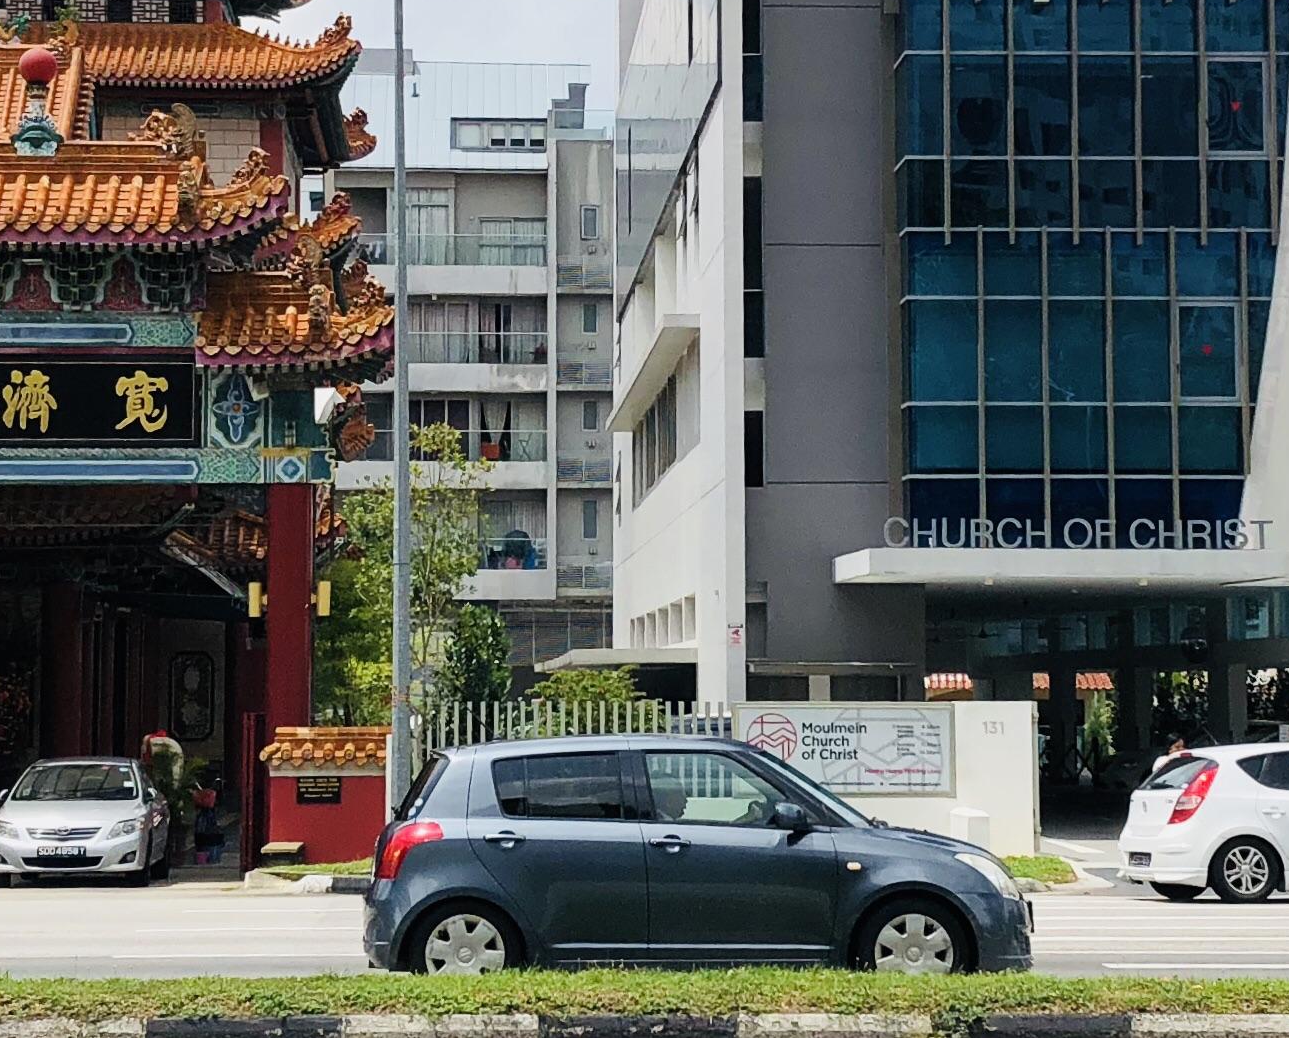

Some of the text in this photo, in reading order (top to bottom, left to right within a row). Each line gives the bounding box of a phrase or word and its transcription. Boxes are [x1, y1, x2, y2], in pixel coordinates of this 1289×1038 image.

[883, 517, 1273, 550] CHURCH OF CHRIST
[801, 722, 868, 734] Moulmein
[982, 721, 1005, 735] 131
[801, 735, 851, 747] Church
[801, 748, 859, 760] of Christ
